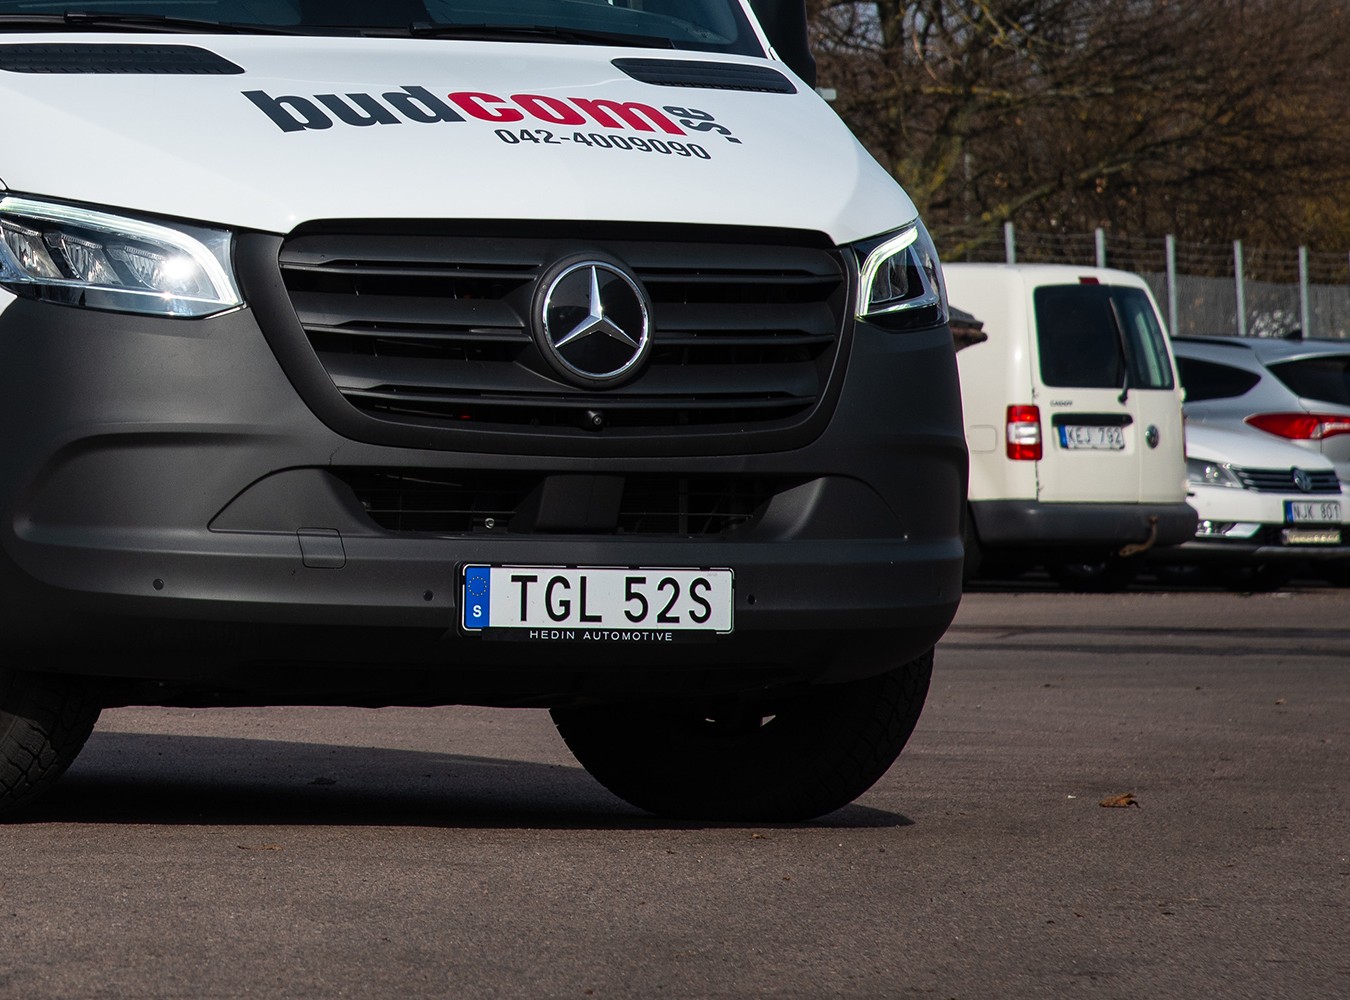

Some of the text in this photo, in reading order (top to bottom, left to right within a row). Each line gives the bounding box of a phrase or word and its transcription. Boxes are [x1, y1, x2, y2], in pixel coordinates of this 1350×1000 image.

[240, 86, 688, 135] budcom
[494, 128, 712, 160] 042-4009090
[1068, 427, 1122, 444] KEJ 792
[1320, 503, 1338, 520] 801
[511, 574, 712, 624] TGL 52S
[472, 605, 482, 618] S
[529, 630, 673, 642] HEDIN AUTOMOTIVE
